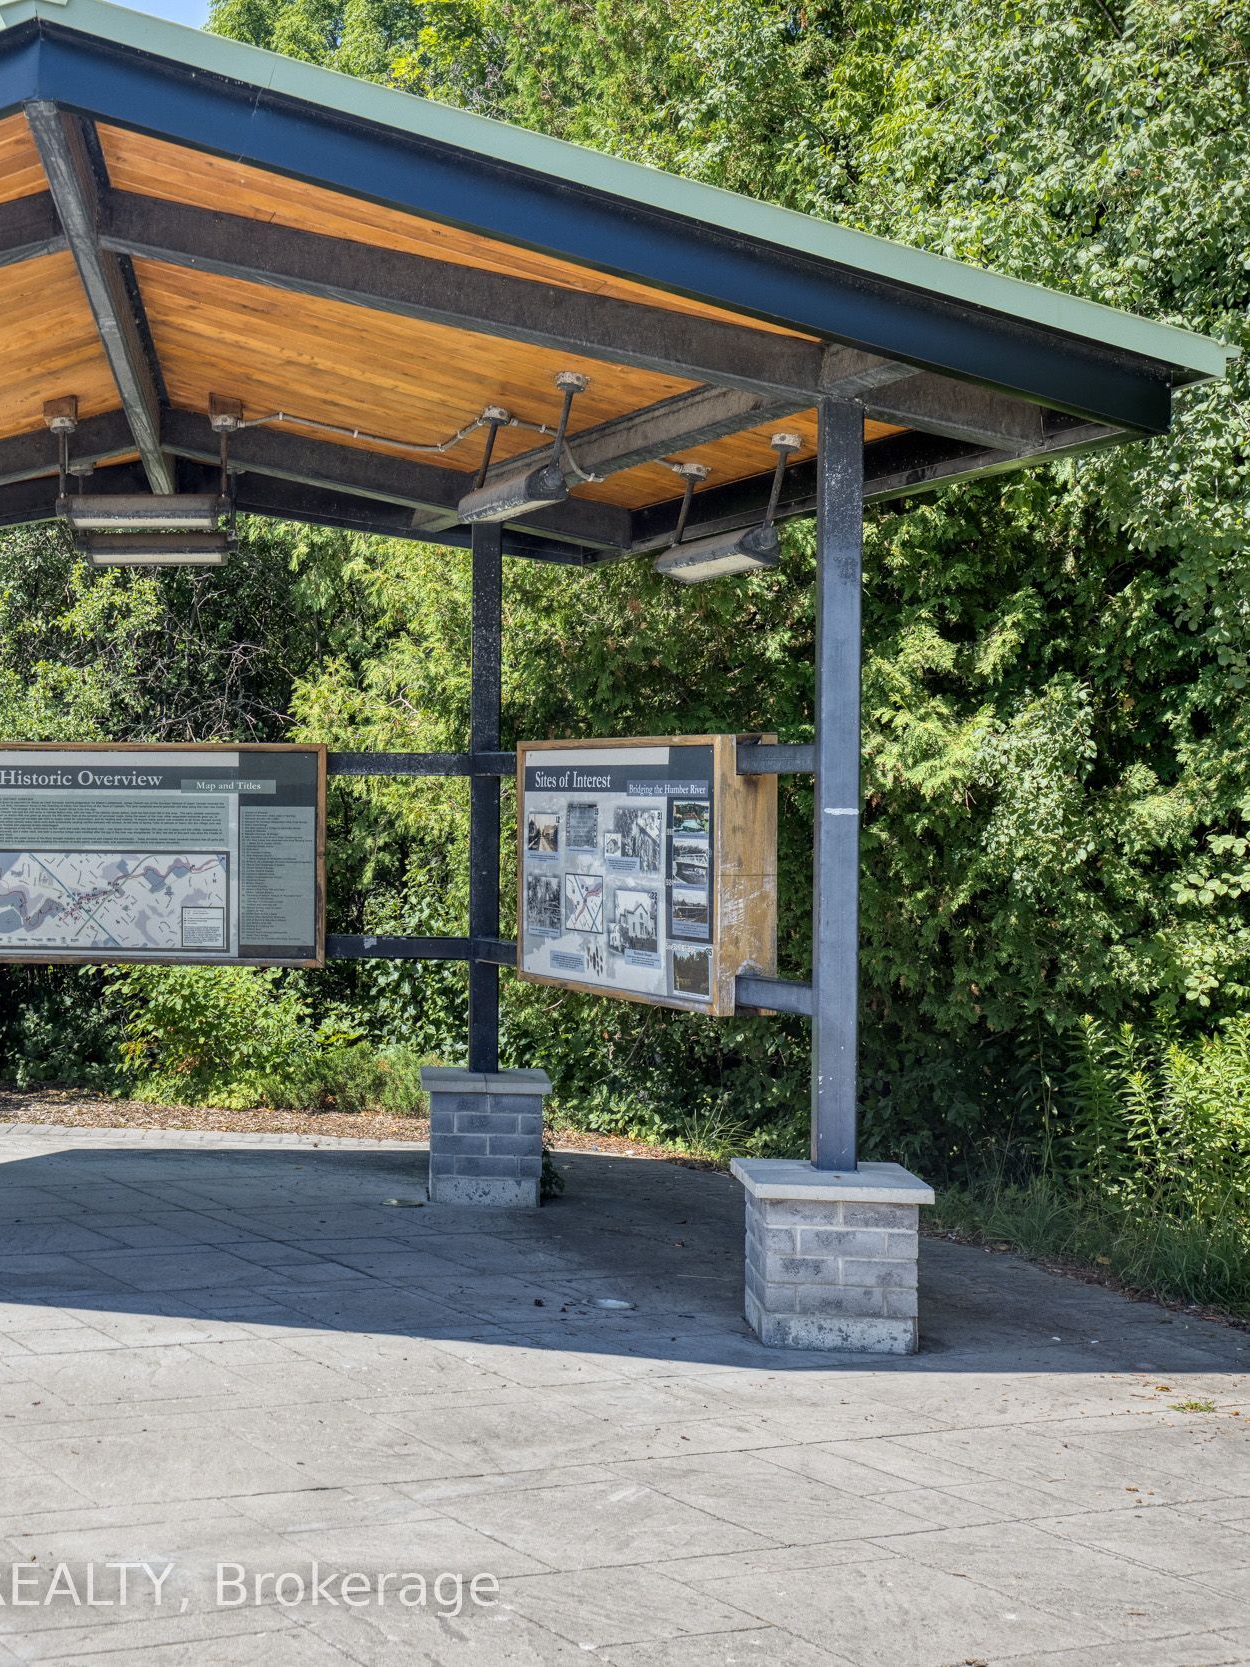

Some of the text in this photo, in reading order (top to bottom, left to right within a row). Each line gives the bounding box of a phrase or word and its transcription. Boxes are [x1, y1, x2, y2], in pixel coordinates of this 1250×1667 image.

[77, 770, 163, 786] Overview
[535, 771, 611, 788] Sites of Interest
[196, 781, 262, 791] Map and Titles
[629, 783, 706, 796] Bridging the Humber River
